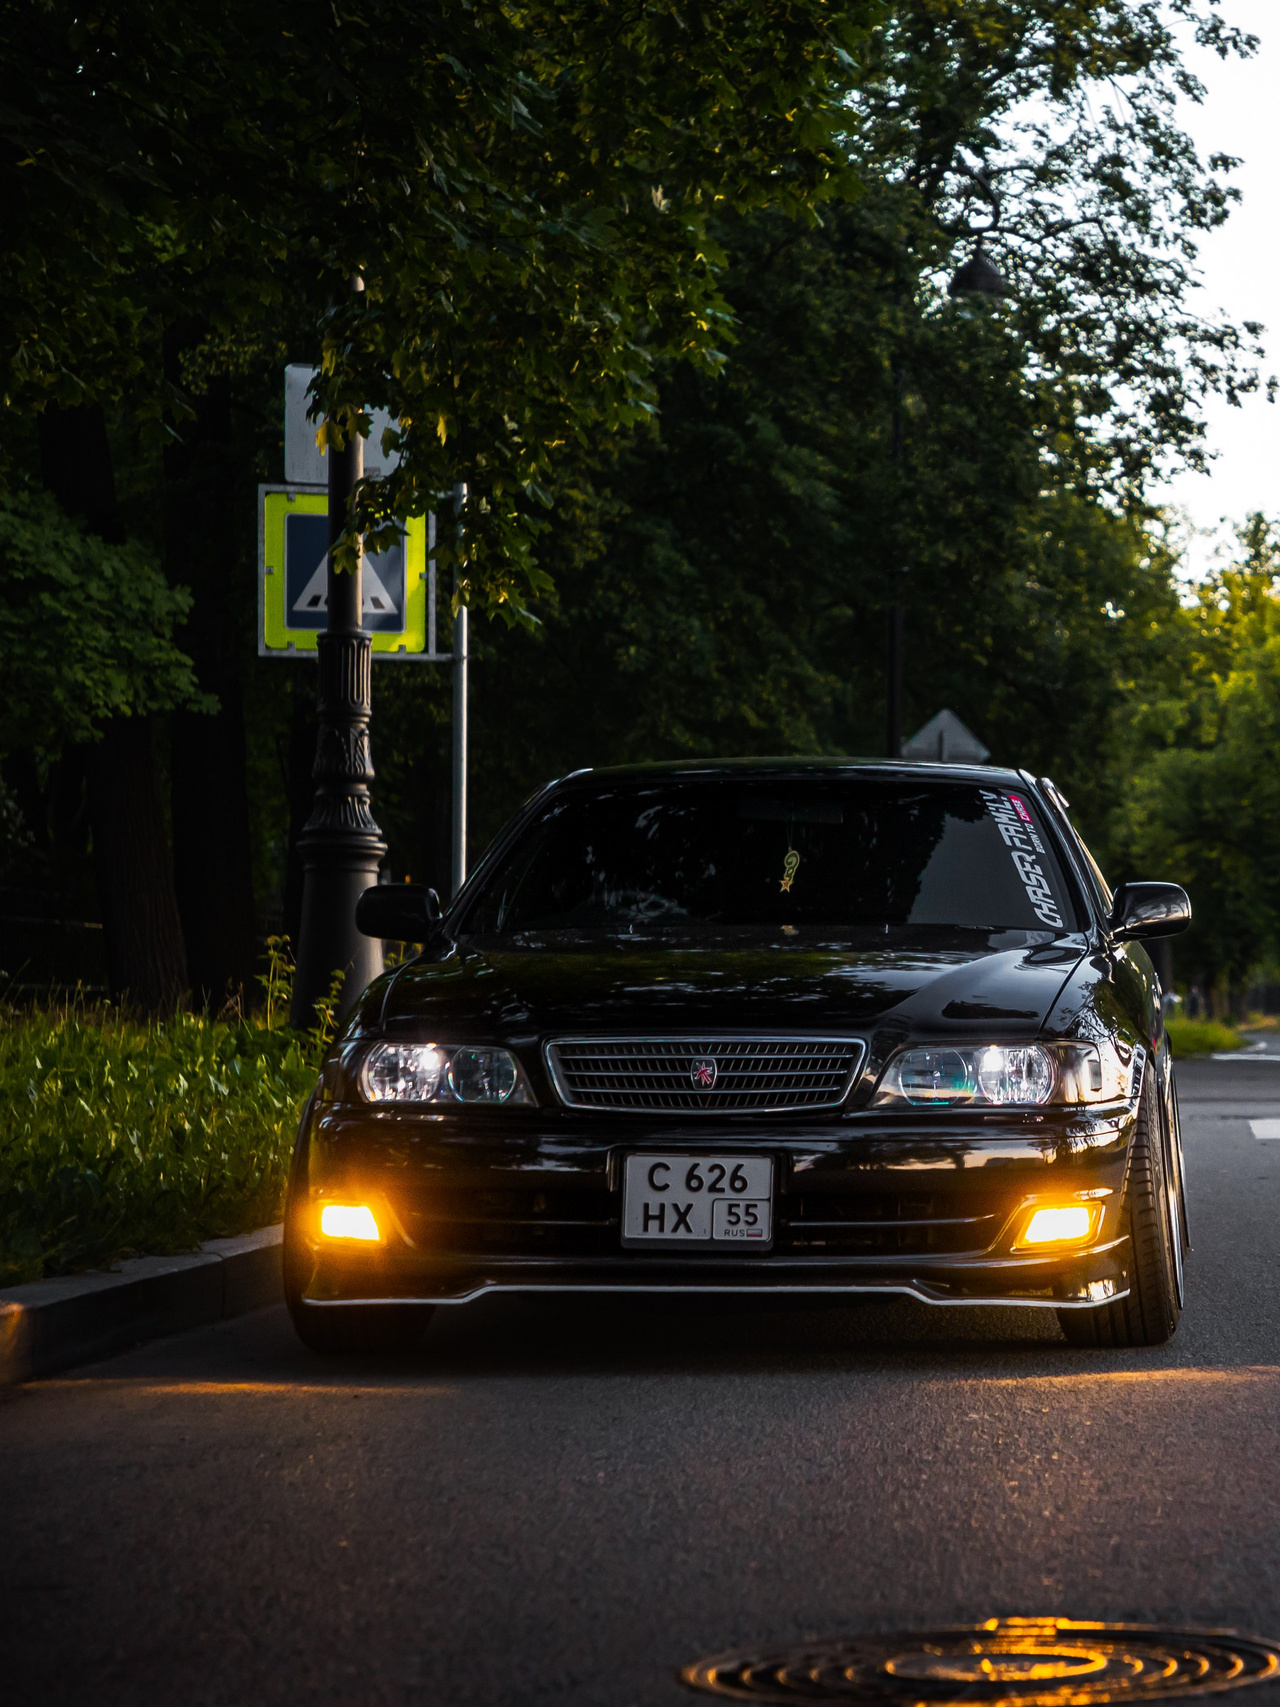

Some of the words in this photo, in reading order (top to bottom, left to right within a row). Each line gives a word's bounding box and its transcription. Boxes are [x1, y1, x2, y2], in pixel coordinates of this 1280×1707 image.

[1011, 798, 1030, 821] CHASE
[1024, 822, 1035, 833] TO
[1029, 832, 1045, 854] BORN
[1011, 850, 1064, 928] CHASER
[648, 1162, 671, 1192] C
[685, 1163, 749, 1193] 626
[643, 1202, 694, 1233] HX
[727, 1203, 759, 1226] 55
[724, 1228, 746, 1237] RUS
